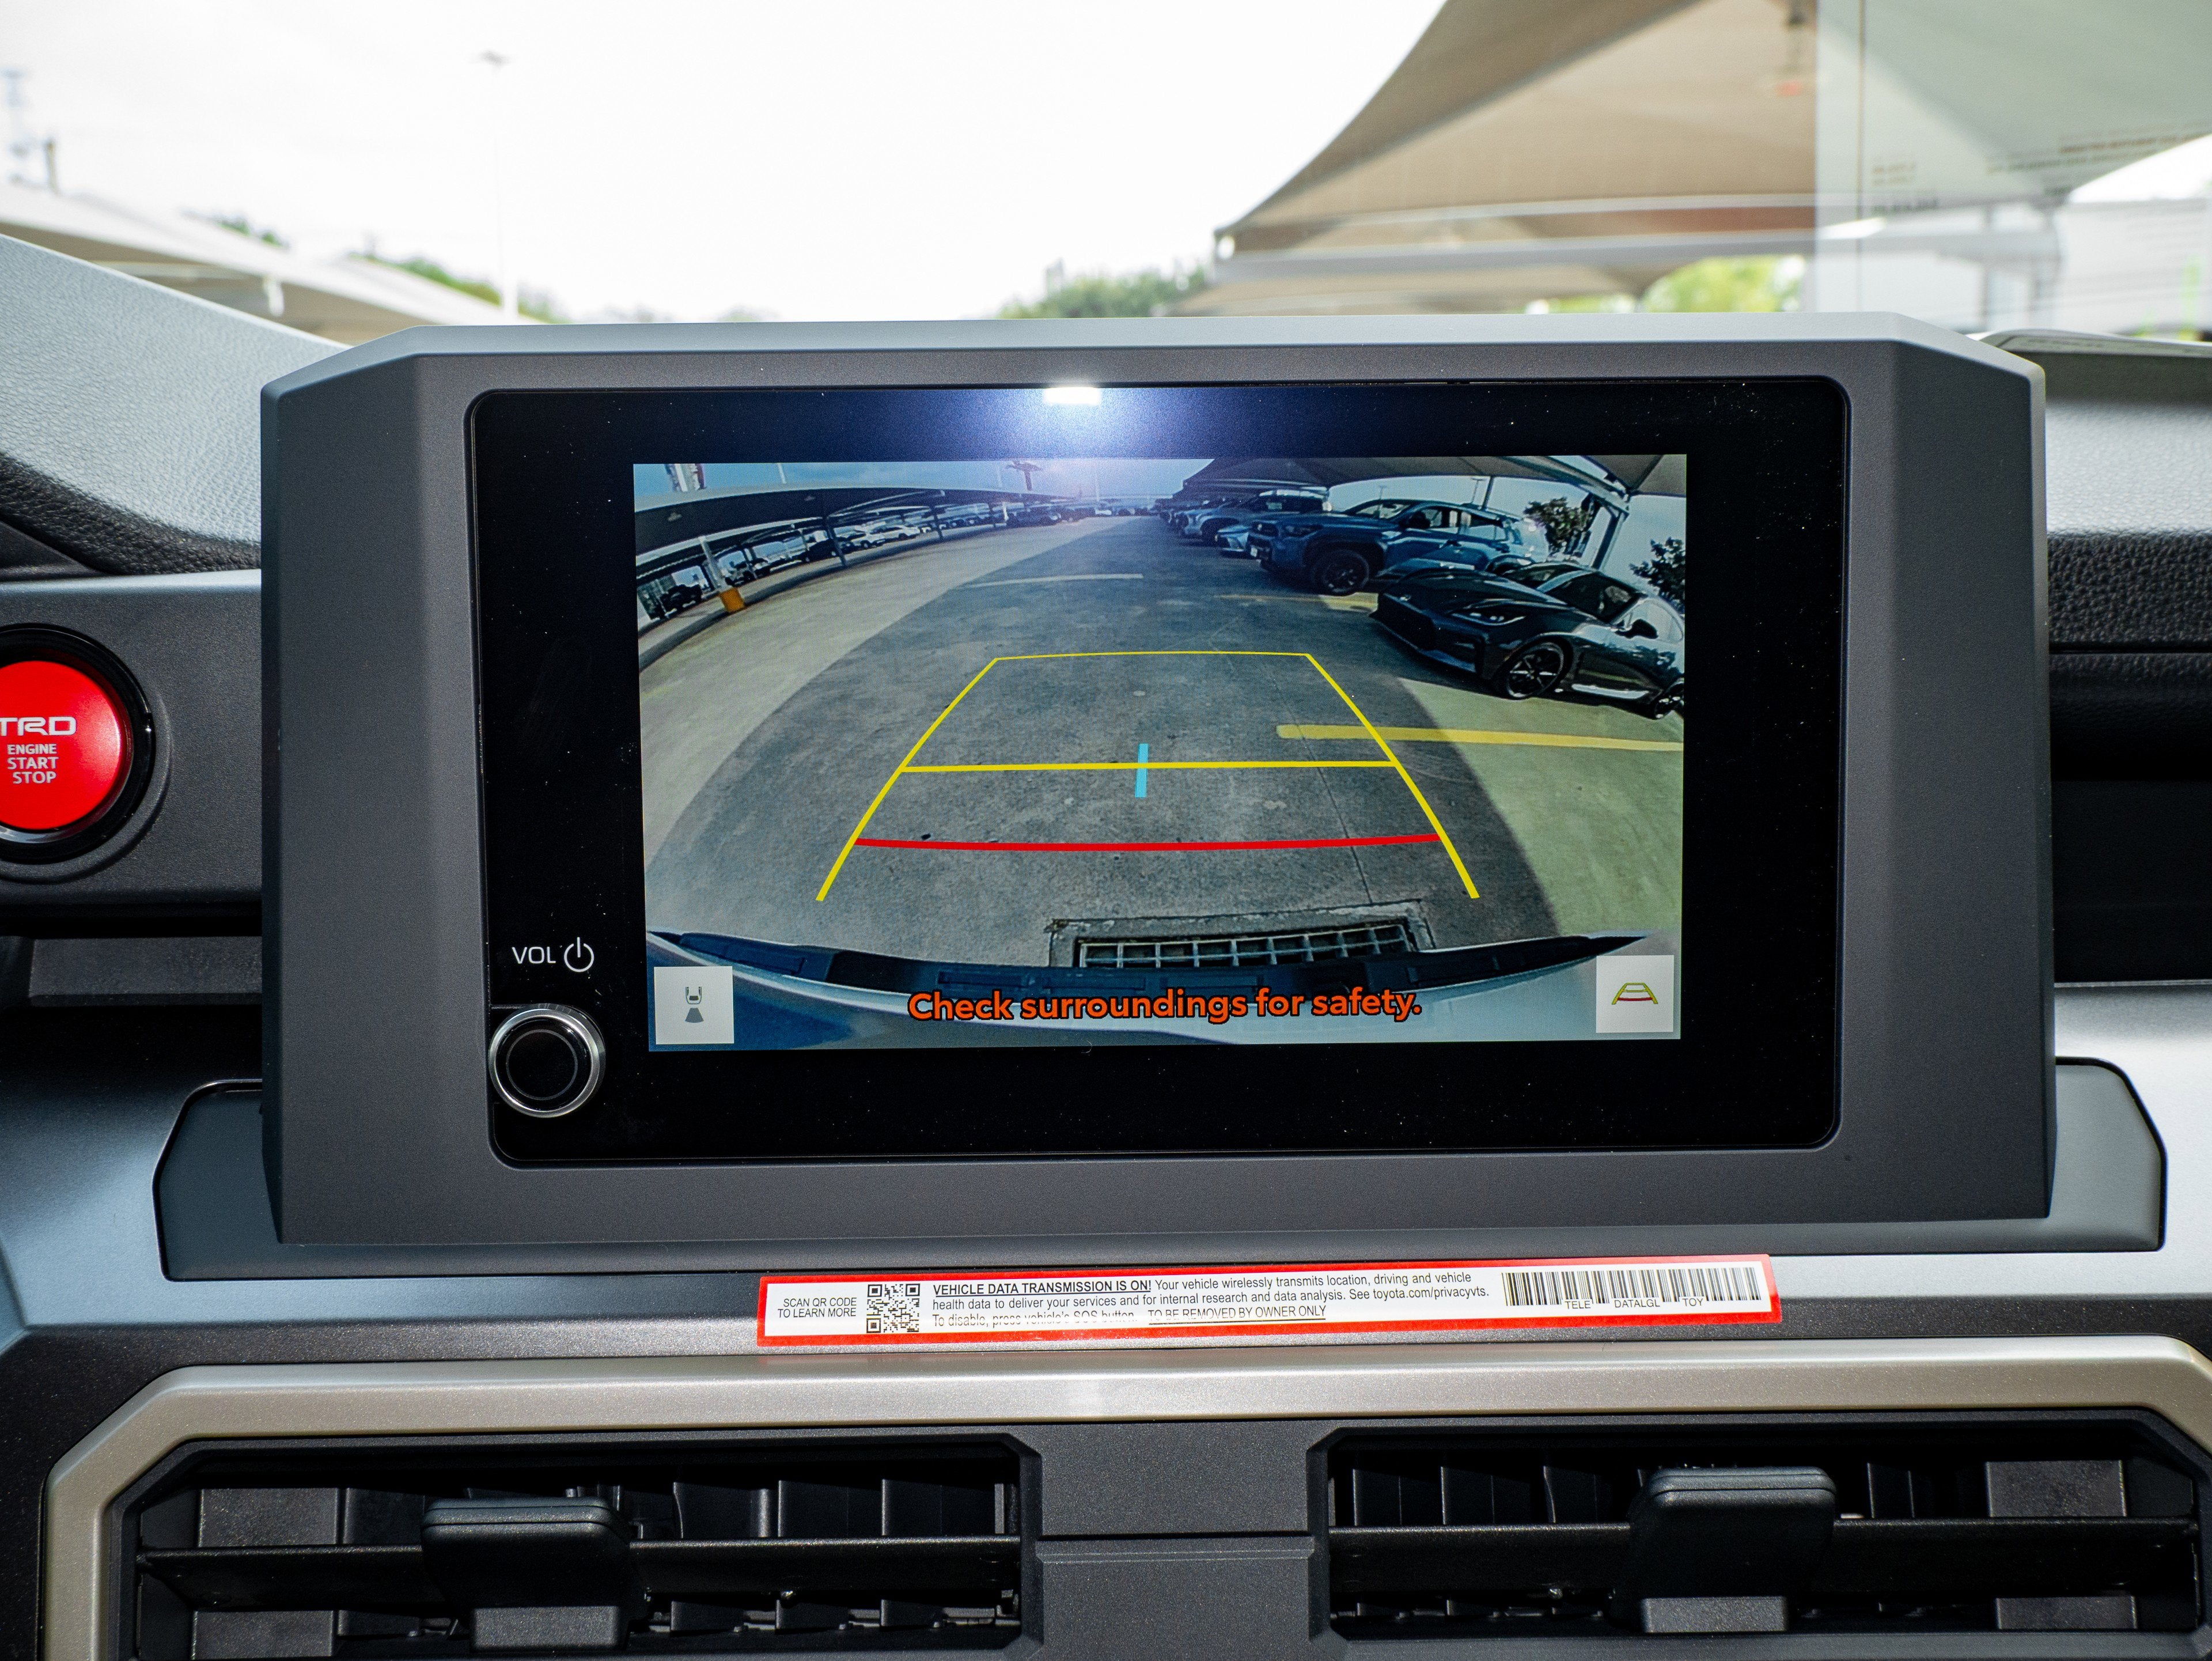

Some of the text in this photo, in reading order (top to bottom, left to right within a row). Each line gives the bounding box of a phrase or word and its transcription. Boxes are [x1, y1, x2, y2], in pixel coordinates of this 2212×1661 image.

[0, 716, 77, 736] TRD
[7, 744, 57, 755] ENGINE
[7, 756, 59, 770] START
[13, 771, 57, 784] STOP
[512, 946, 556, 964] VOL
[908, 986, 1423, 1024] Check surroundings for safety.
[933, 1272, 1471, 1295] VEHICLE DATA TRANSMISSION IS ON! Your vehicle wirelessly transmits location, driving and vehicle
[783, 1297, 857, 1307] SCAN QR CODE
[933, 1285, 1490, 1310] health data to deliver your services and for internal research and data analysis. See toyota.com/privacyvts.
[1565, 1297, 1704, 1310] TELE DATALGL TOY
[778, 1307, 857, 1318] TO LEARN MORE
[932, 1314, 945, 1328] To
[1183, 1307, 1236, 1320] REMOVED
[1238, 1307, 1253, 1318] BY
[1255, 1305, 1296, 1317] OWNER
[1298, 1304, 1326, 1316] ONLY
